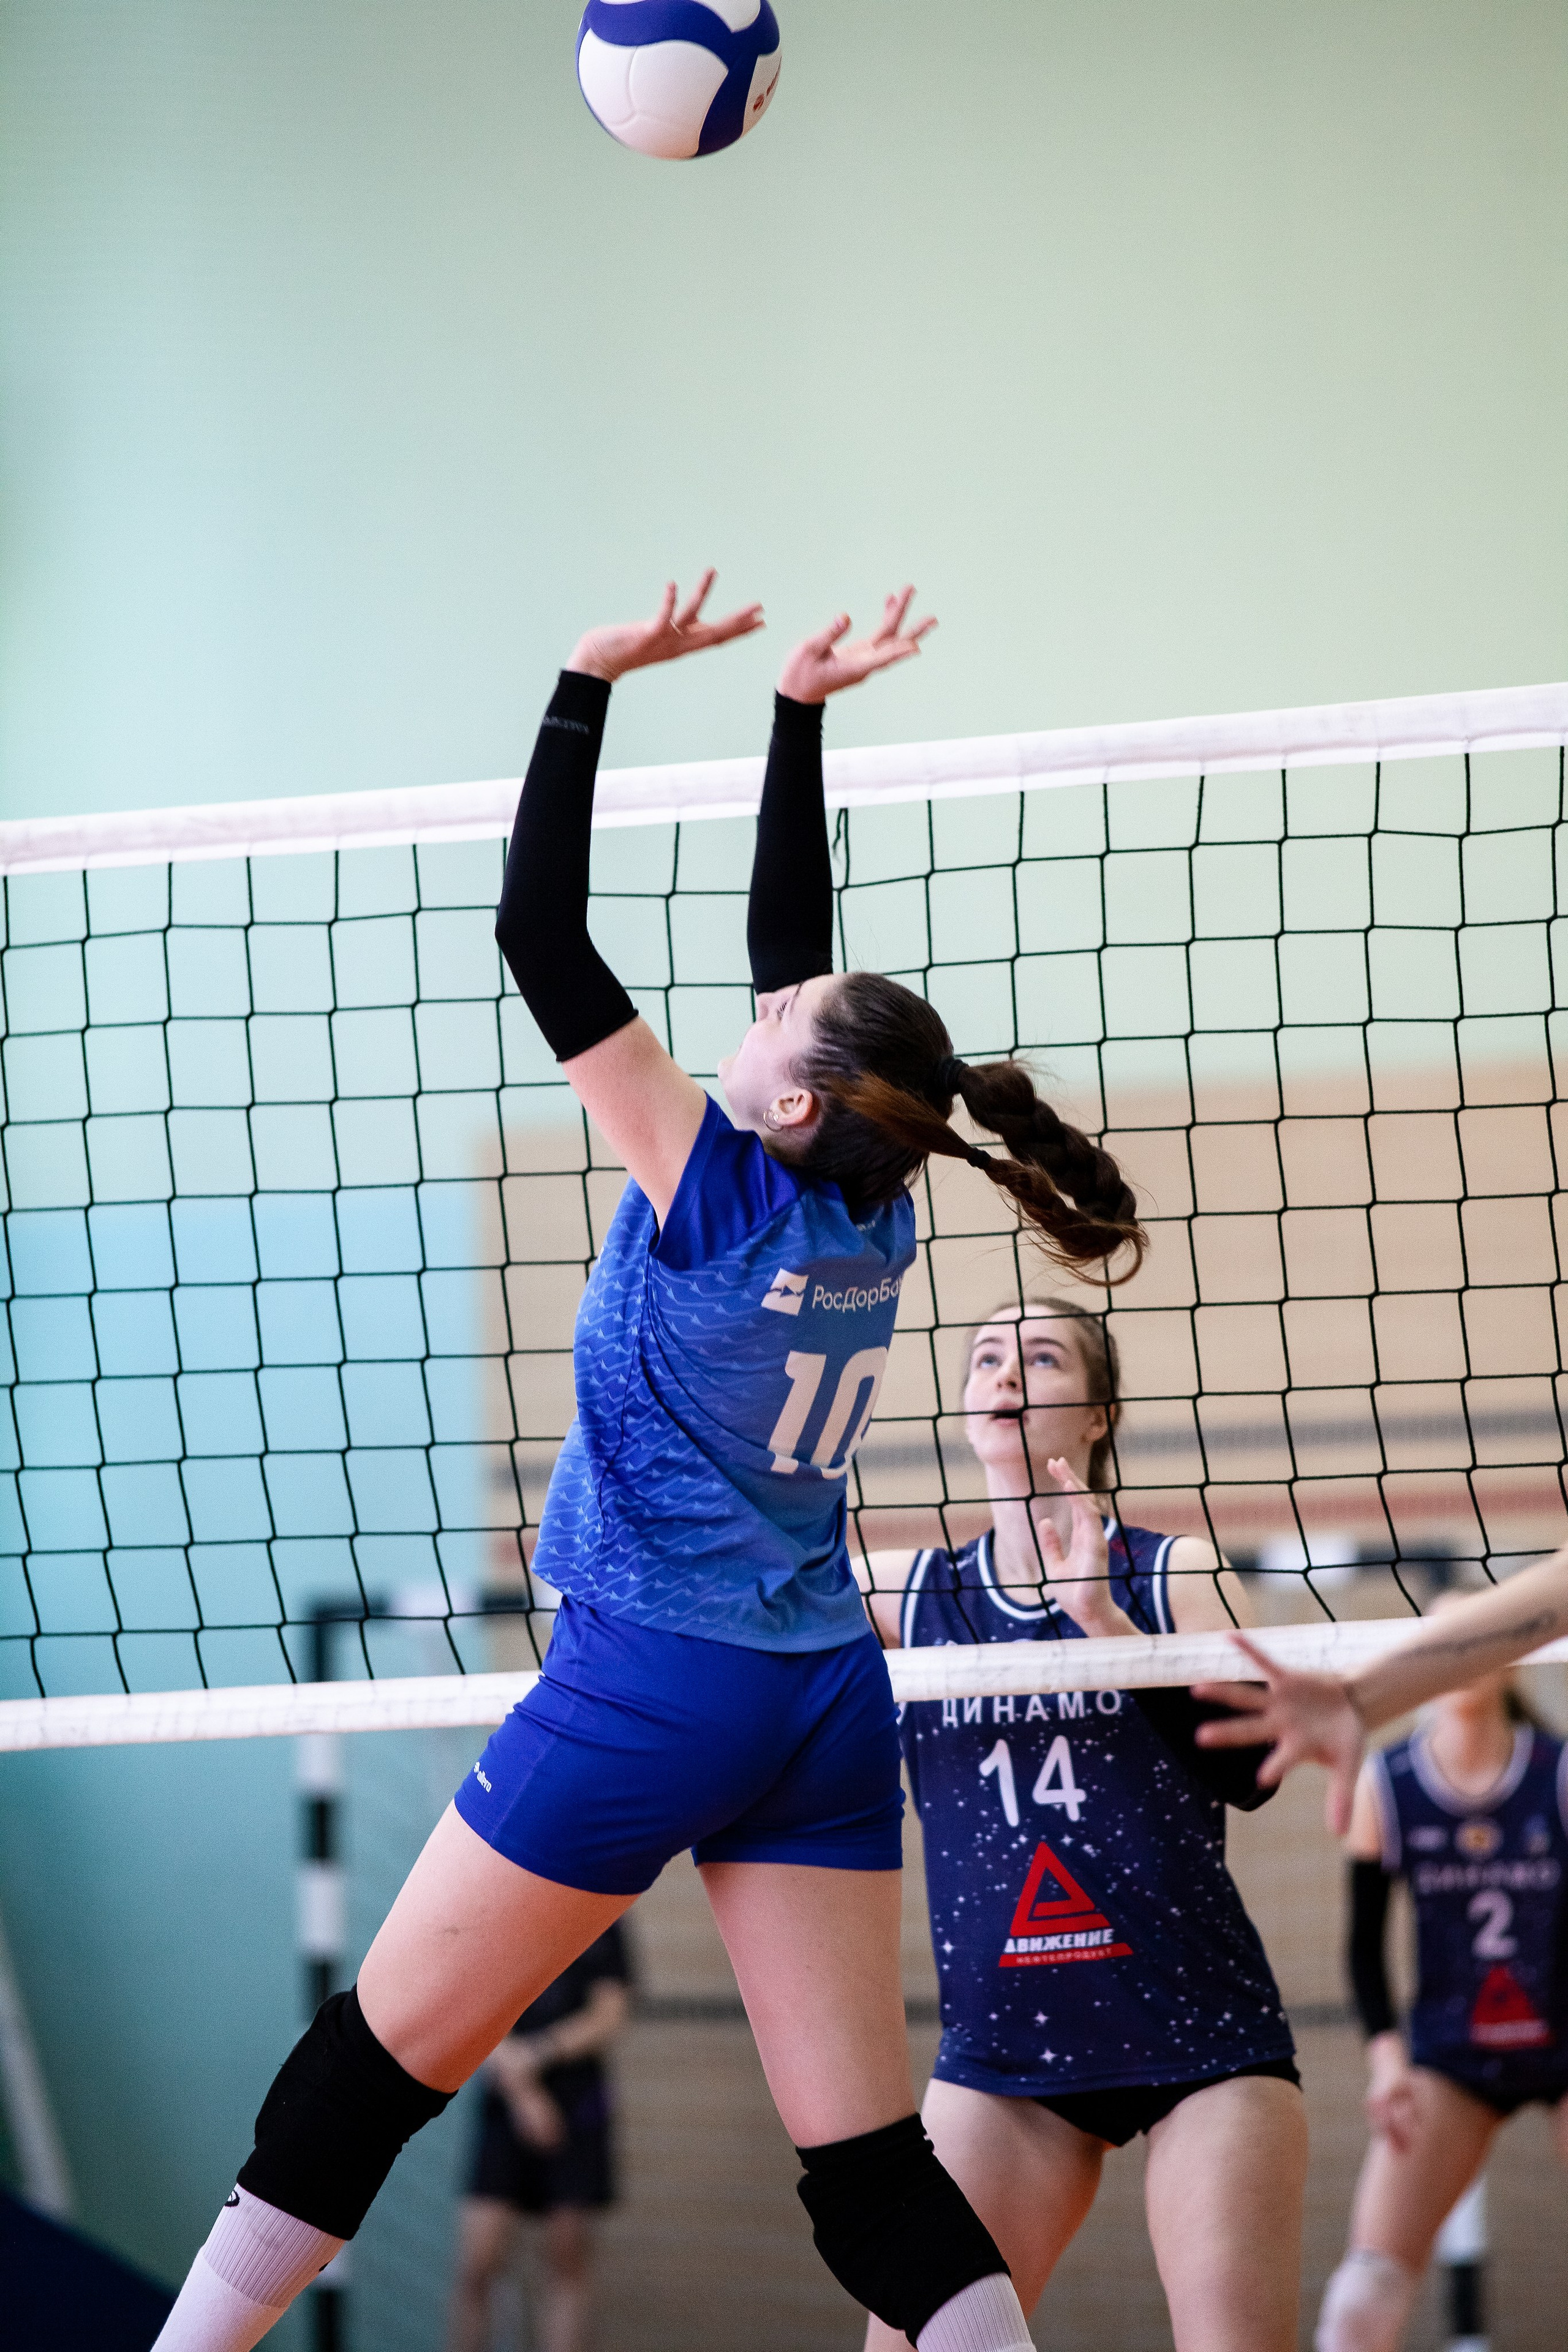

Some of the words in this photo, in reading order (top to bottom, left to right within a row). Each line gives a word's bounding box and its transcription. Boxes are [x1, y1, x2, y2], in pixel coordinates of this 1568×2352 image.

[812, 1276, 902, 1313] РосДорБа
[768, 1346, 888, 1479] 10
[942, 1689, 1121, 1728] ДИНАМО
[979, 1735, 1087, 1827] 14
[1468, 1889, 1518, 1959] 2
